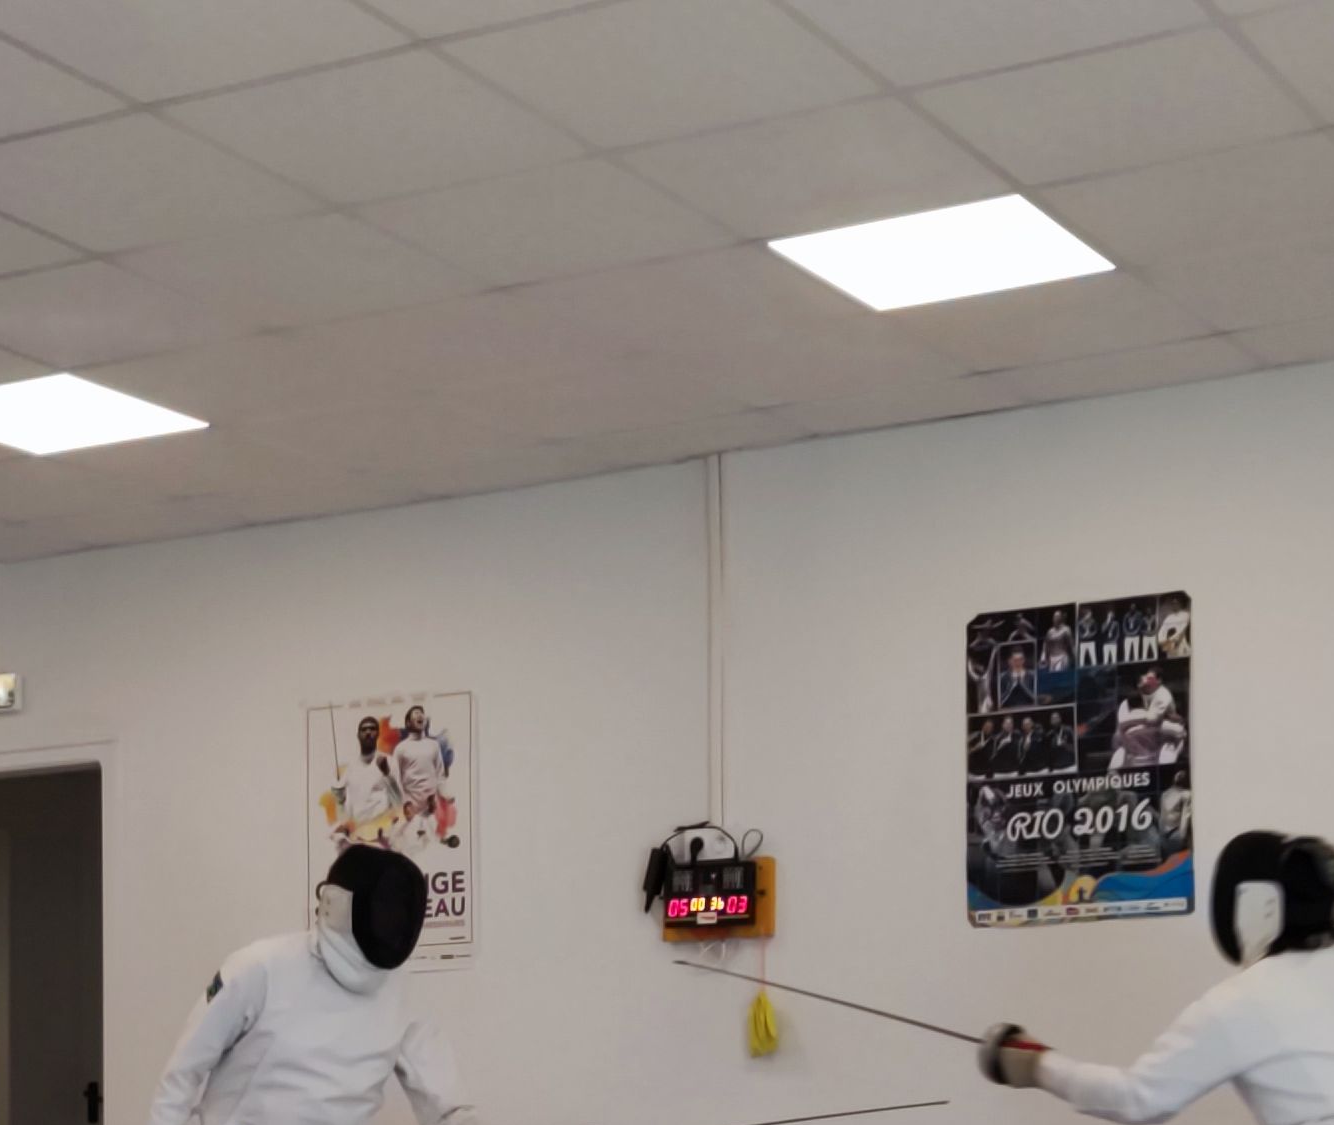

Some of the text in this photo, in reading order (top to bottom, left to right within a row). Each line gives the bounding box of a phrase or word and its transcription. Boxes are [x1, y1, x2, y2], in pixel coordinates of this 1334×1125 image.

[1006, 772, 1151, 799] JEUX OLYMPIQUES
[1006, 798, 1153, 842] RIO 2016
[423, 896, 466, 920] EAU
[667, 898, 689, 918] 05
[727, 895, 748, 914] 03
